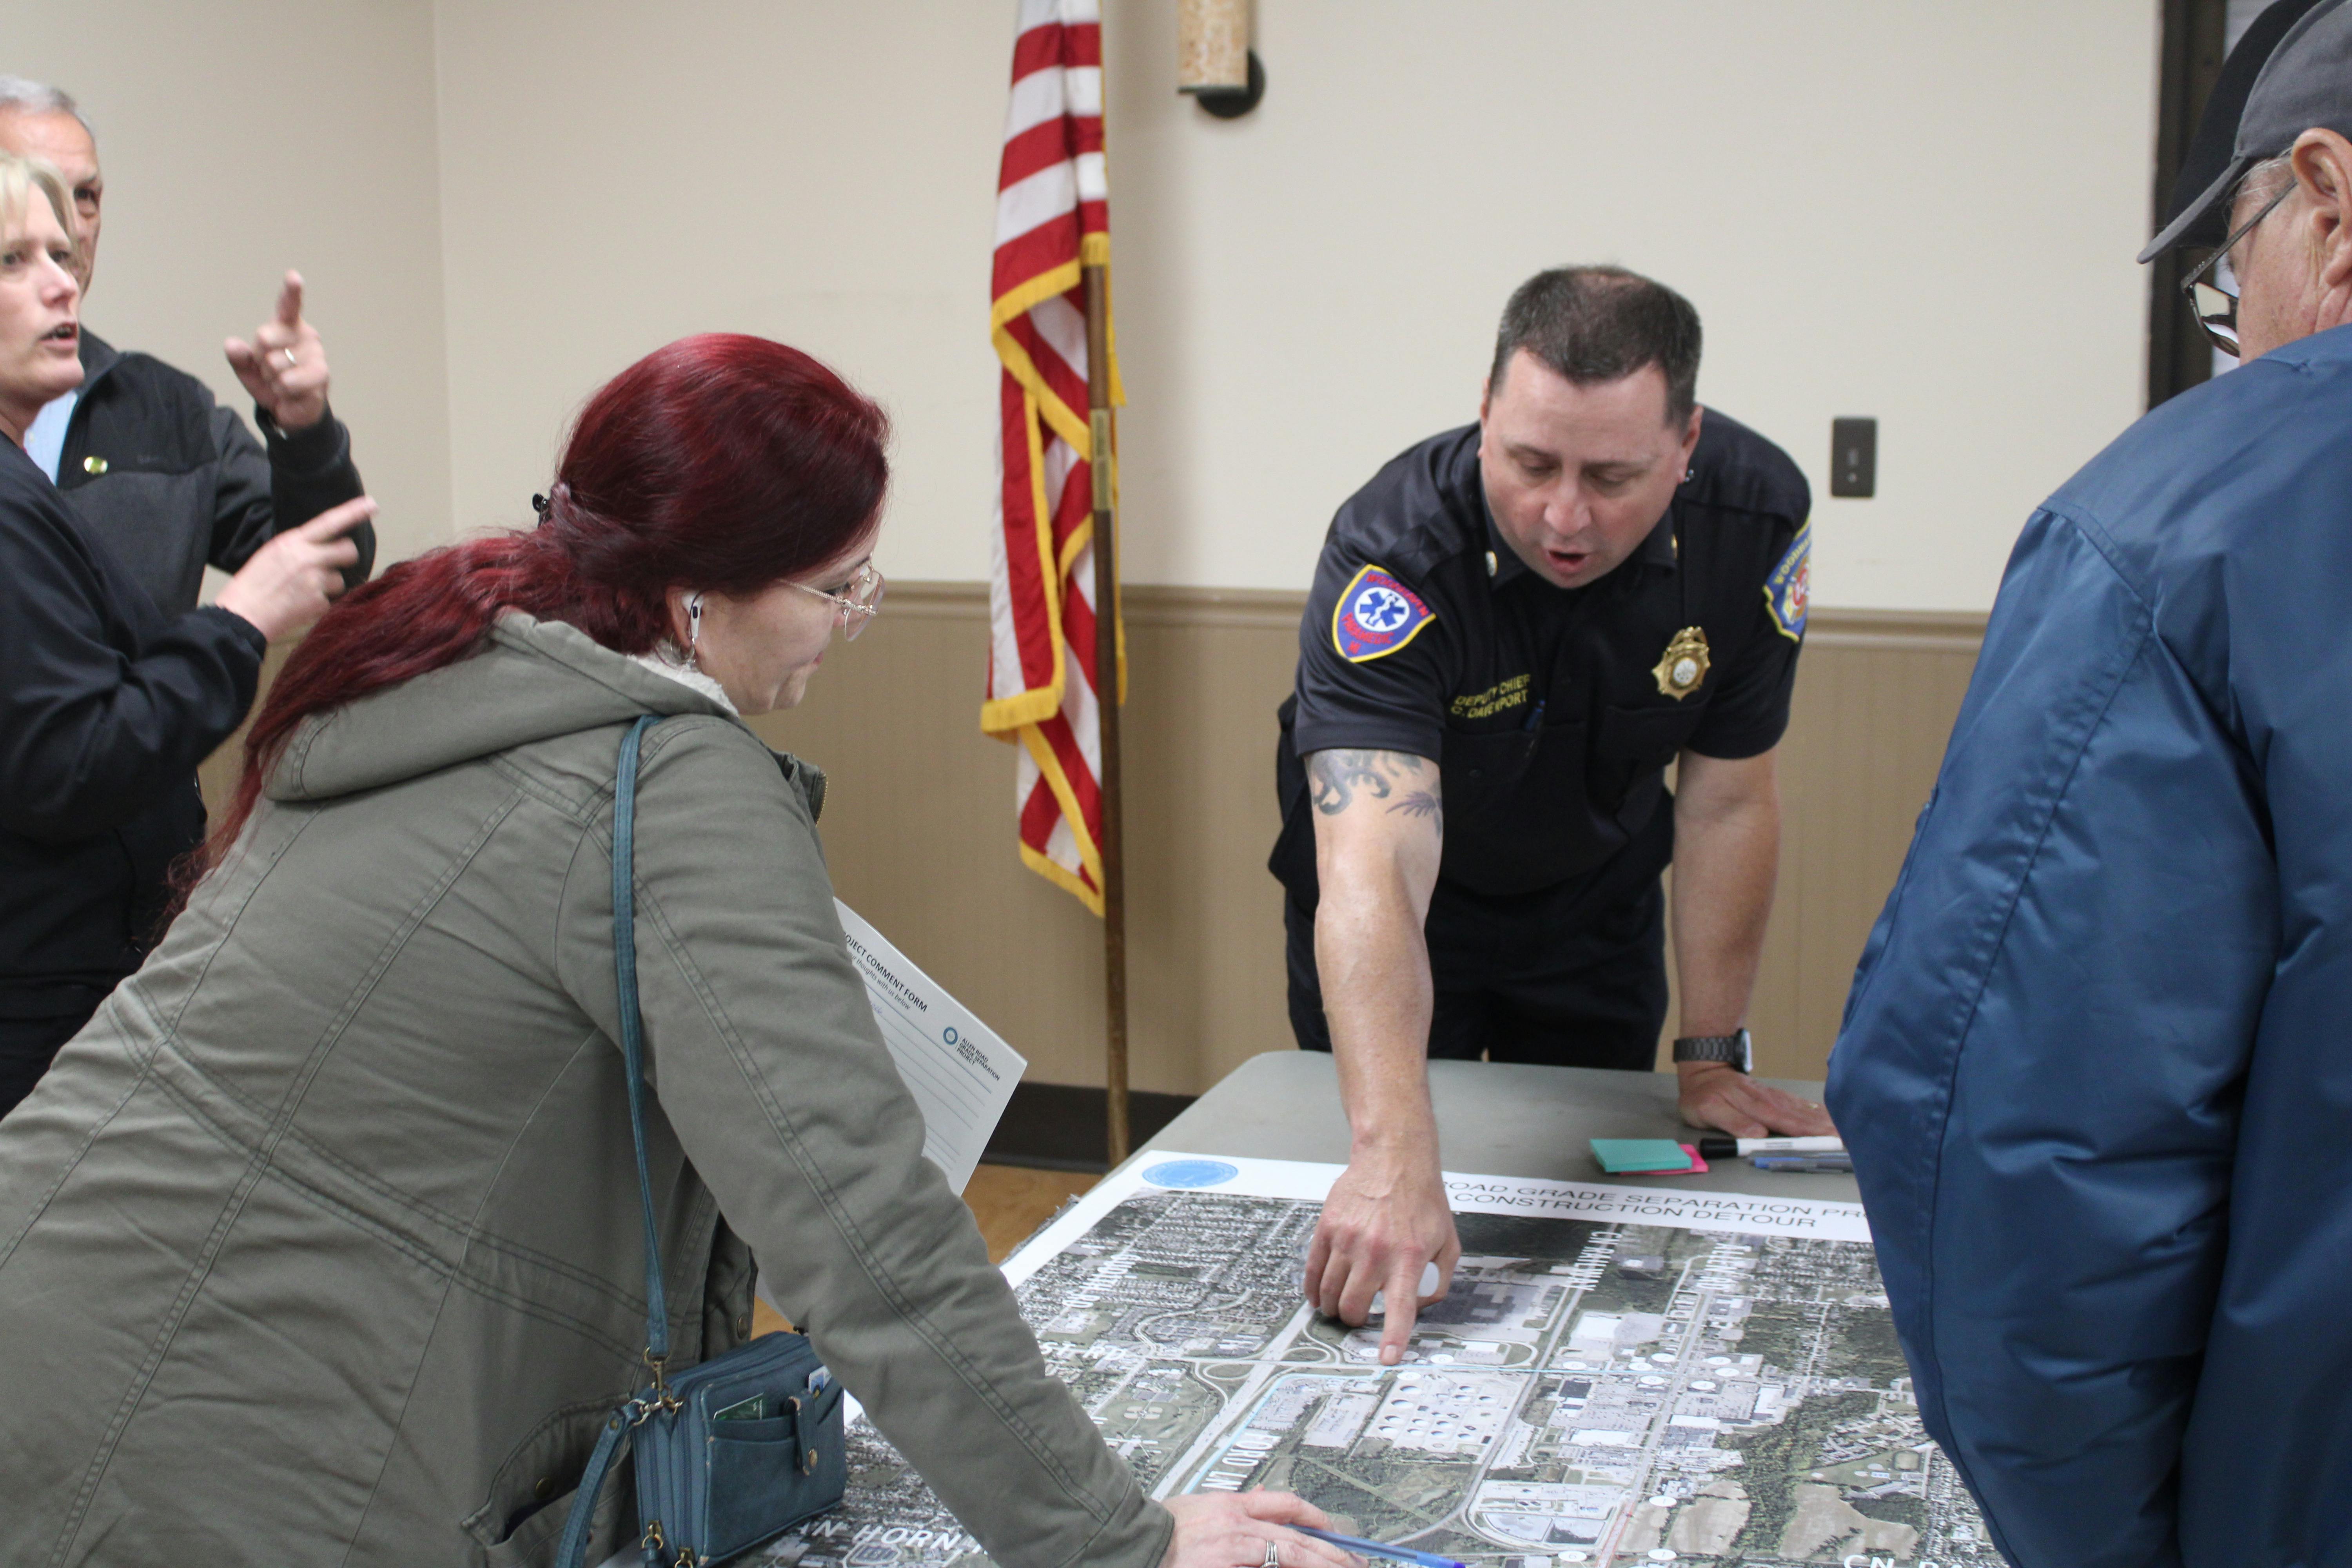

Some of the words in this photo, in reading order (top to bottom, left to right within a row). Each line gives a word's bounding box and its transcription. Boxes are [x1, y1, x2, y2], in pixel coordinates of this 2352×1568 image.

[1499, 673, 1531, 695] CHIEF
[844, 932, 867, 956] OJECT
[866, 954, 905, 991] COMMENT
[904, 989, 928, 1012] FORM
[856, 958, 877, 980] thoughts
[877, 979, 888, 991] with
[895, 993, 911, 1010] below
[956, 1048, 975, 1065] PROJECT
[959, 1043, 975, 1057] GRADE
[974, 1056, 1001, 1082] SEPARATION
[962, 1038, 976, 1052] ALLEN
[975, 1050, 989, 1063] ROAD
[1444, 1180, 1508, 1192] OAD
[1517, 1188, 1616, 1201] GRADE
[1625, 1194, 1811, 1215] SEPARATION
[1822, 1209, 1867, 1218] PR
[1455, 1193, 1683, 1216] CONSTRUCTION
[1692, 1210, 1817, 1227] DETOUR
[1062, 1292, 1100, 1309] RD
[1222, 1432, 1282, 1467] FORD
[1201, 1470, 1248, 1491] LN
[852, 1524, 962, 1551] HORN
